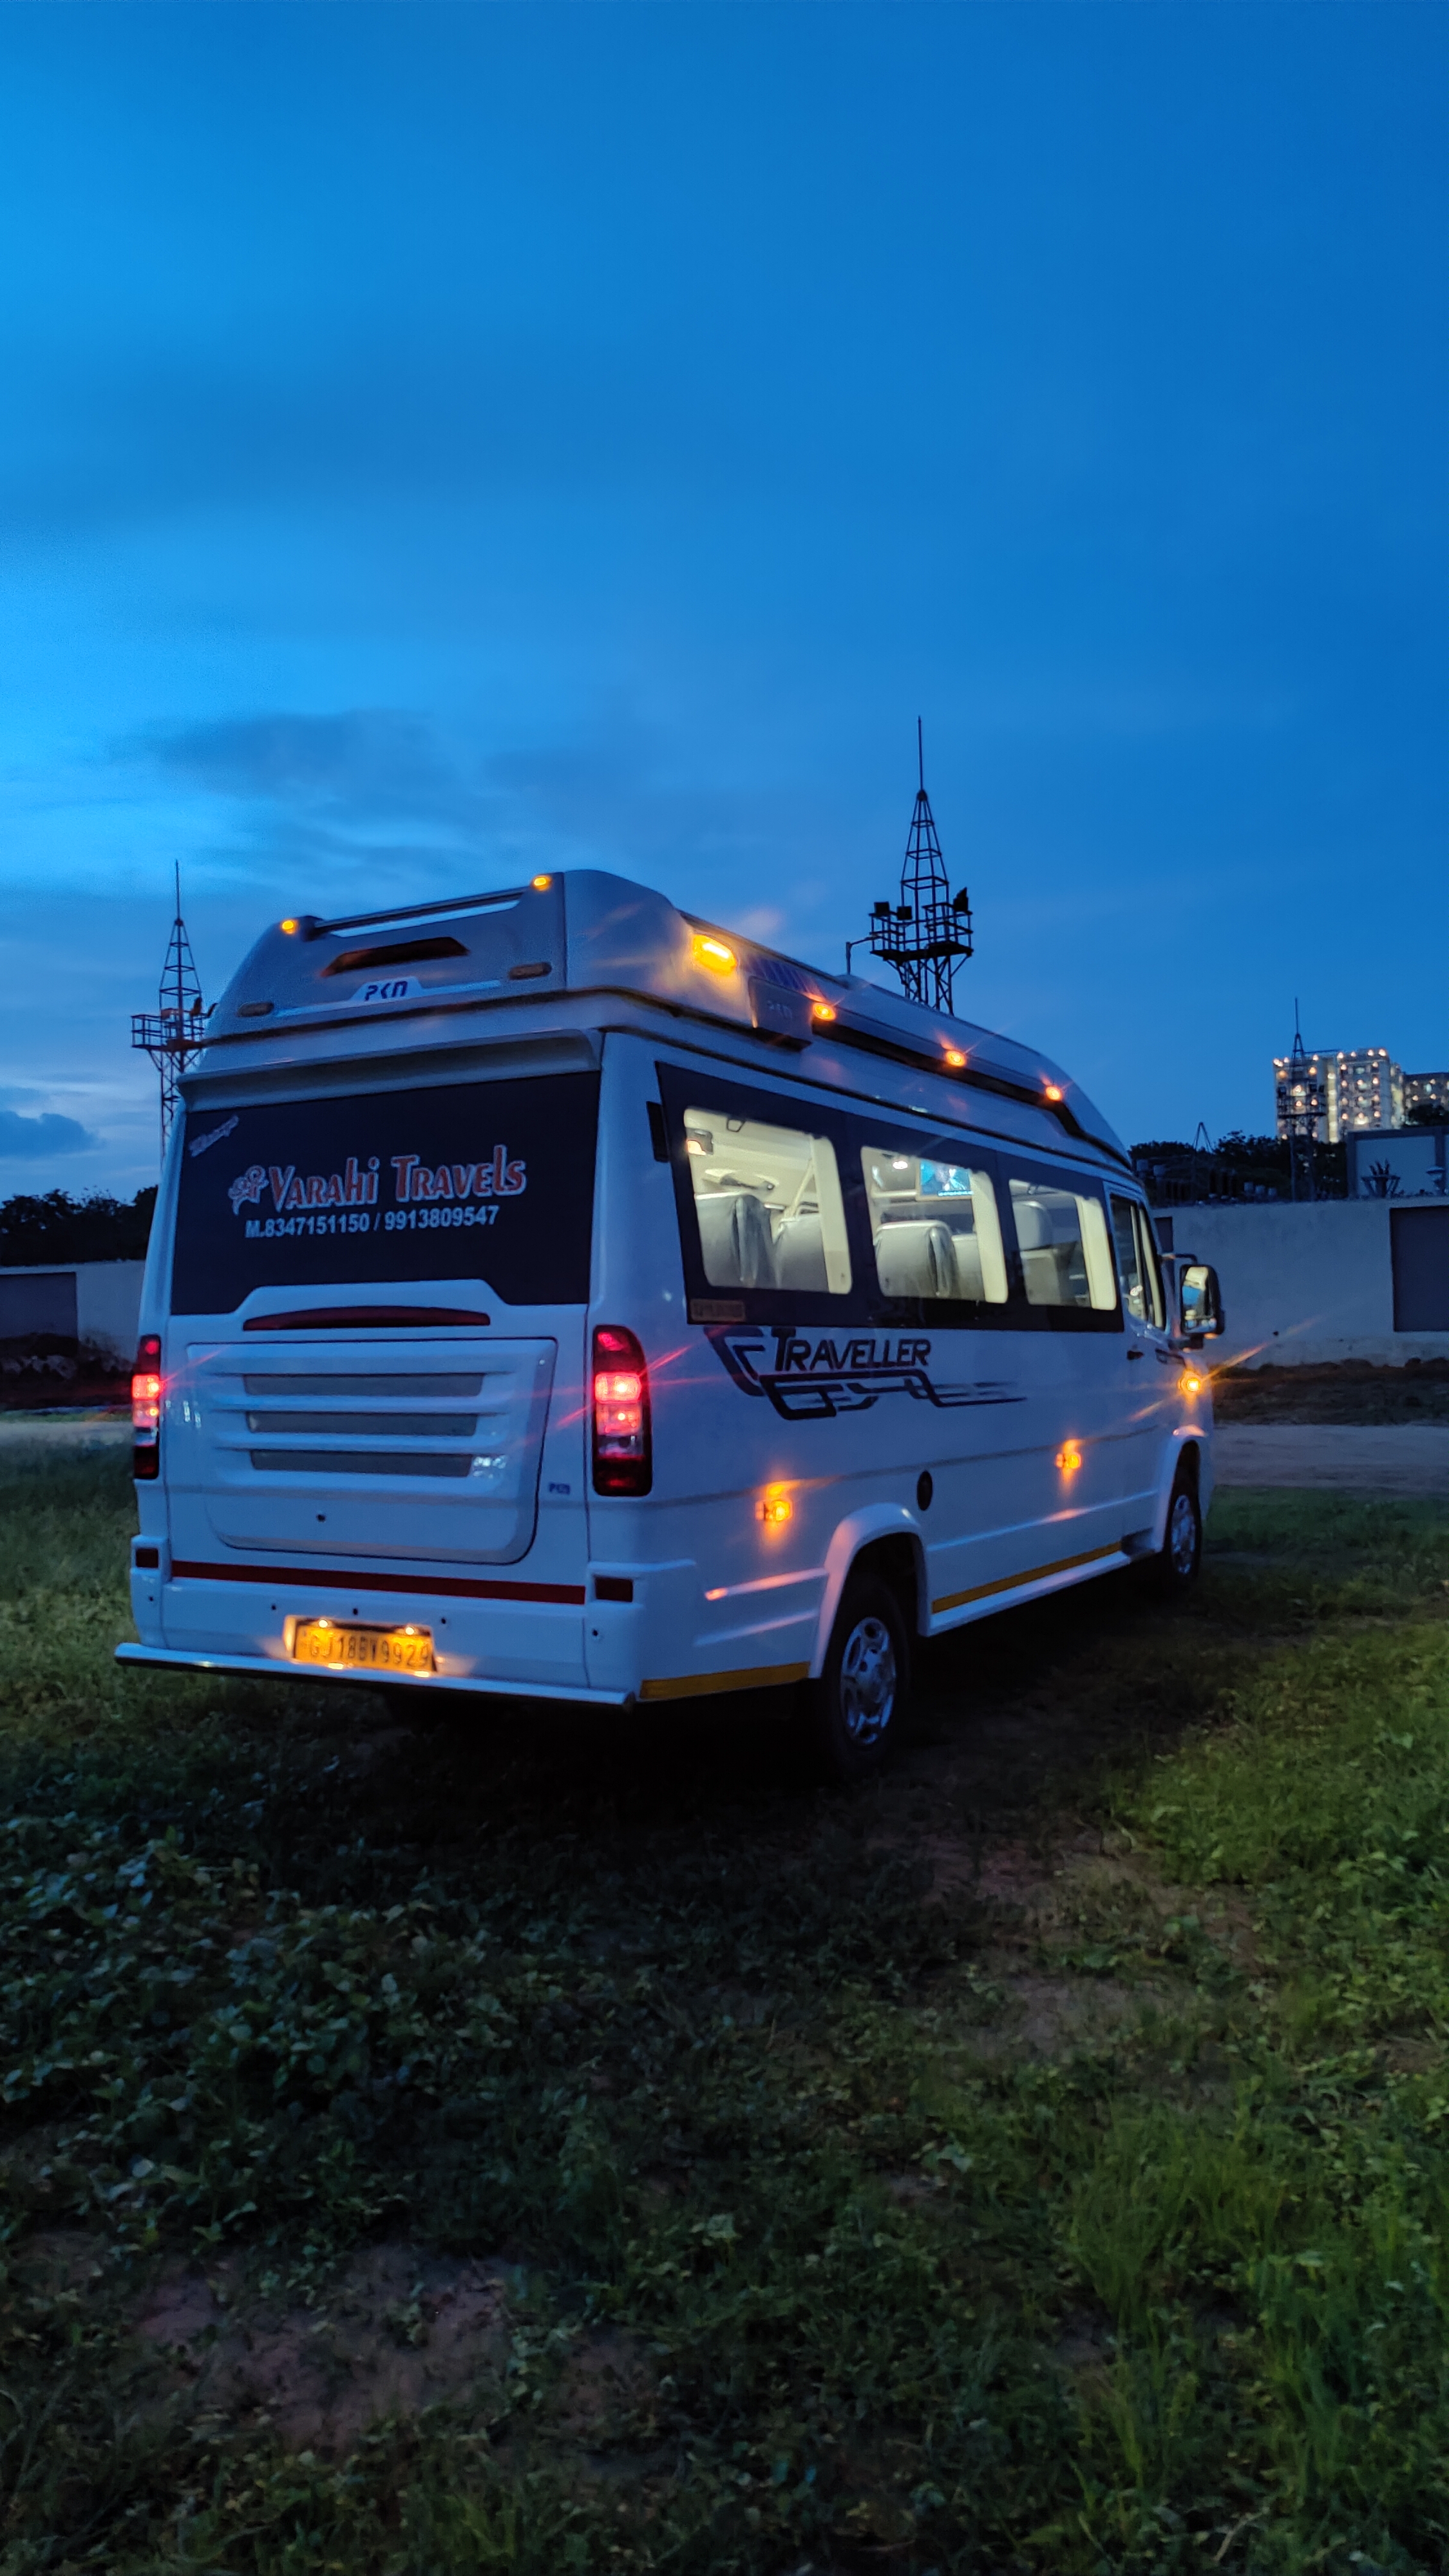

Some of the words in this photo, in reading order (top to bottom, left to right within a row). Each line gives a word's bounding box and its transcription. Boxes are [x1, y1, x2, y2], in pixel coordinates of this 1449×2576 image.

[245, 1212, 370, 1238] M.8347151150
[384, 1204, 500, 1231] 9913809547
[771, 1326, 931, 1372] TRAVELLER
